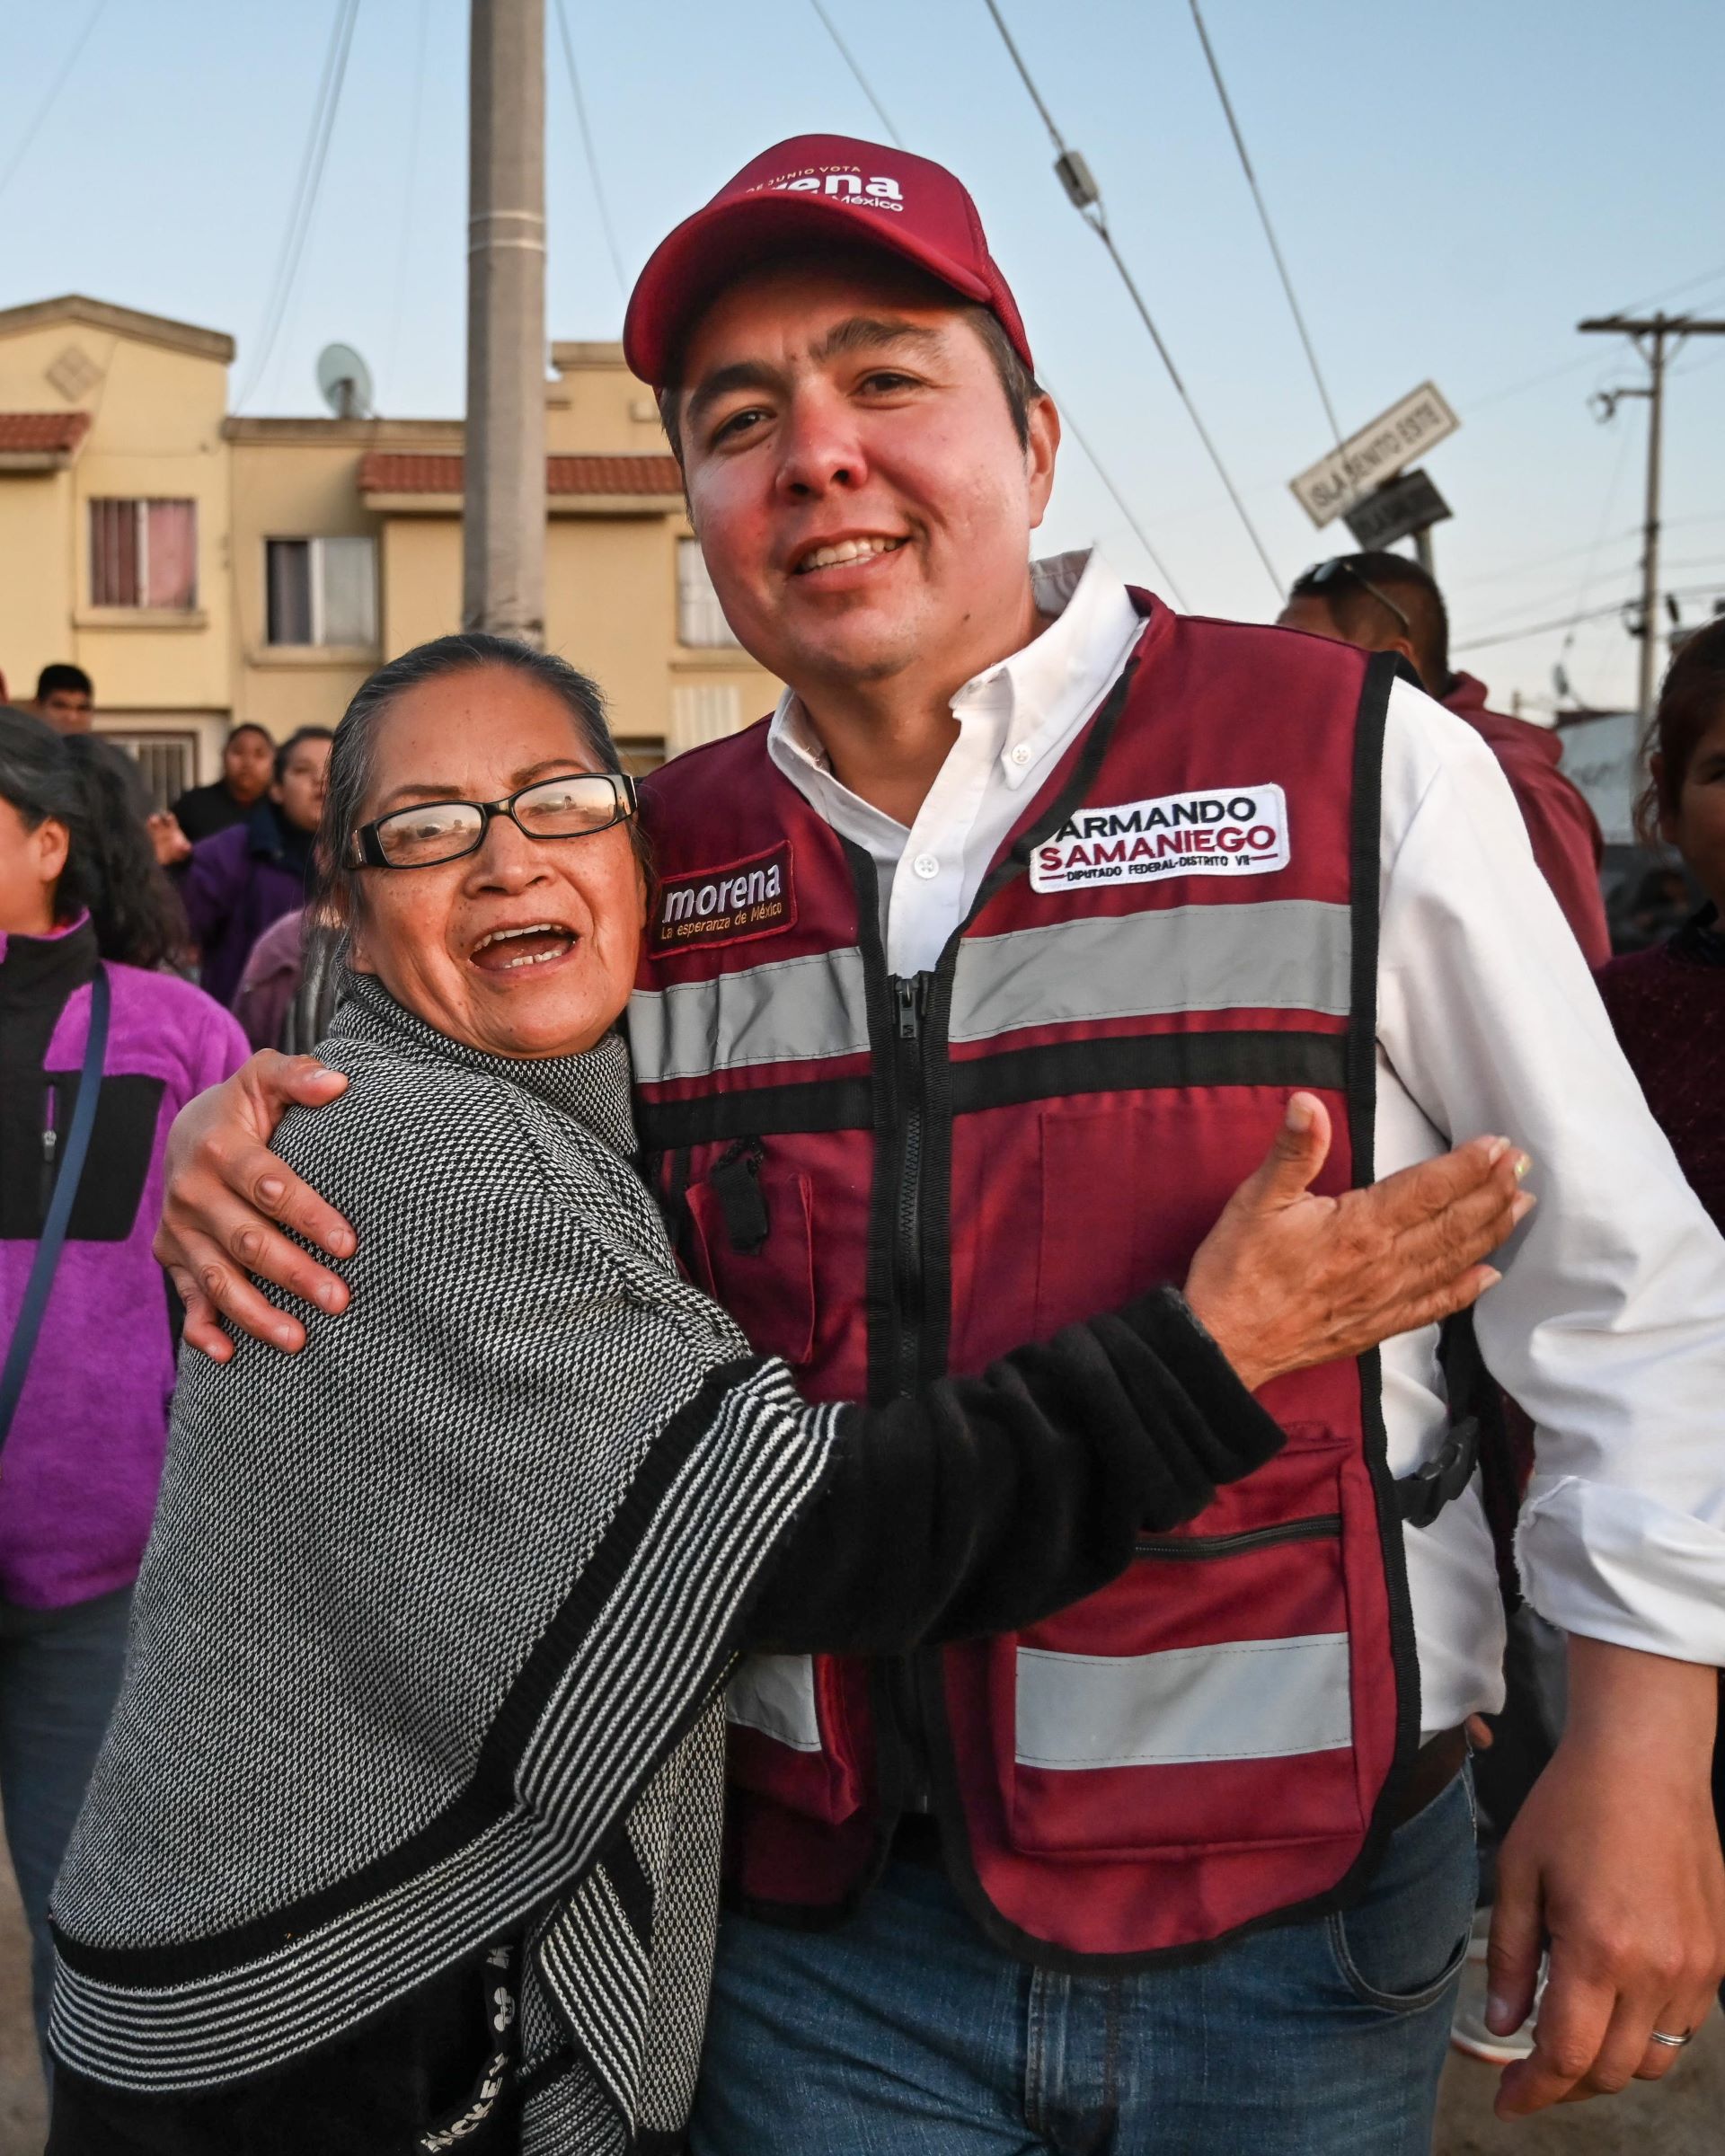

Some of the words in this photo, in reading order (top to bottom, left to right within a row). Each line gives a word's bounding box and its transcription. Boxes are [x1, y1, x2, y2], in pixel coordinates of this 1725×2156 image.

[768, 168, 815, 186] JUNIO
[819, 165, 861, 173] VOTA
[1396, 403, 1440, 445] ESTE
[1056, 797, 1257, 843] ARMANDO
[1039, 825, 1277, 871] SAMANIEGO
[661, 863, 781, 924] morena
[1066, 866, 1123, 882] DIPUTADO
[660, 926, 673, 941] La
[677, 916, 730, 940] esperanza
[734, 909, 748, 926] de
[750, 901, 783, 923] México
